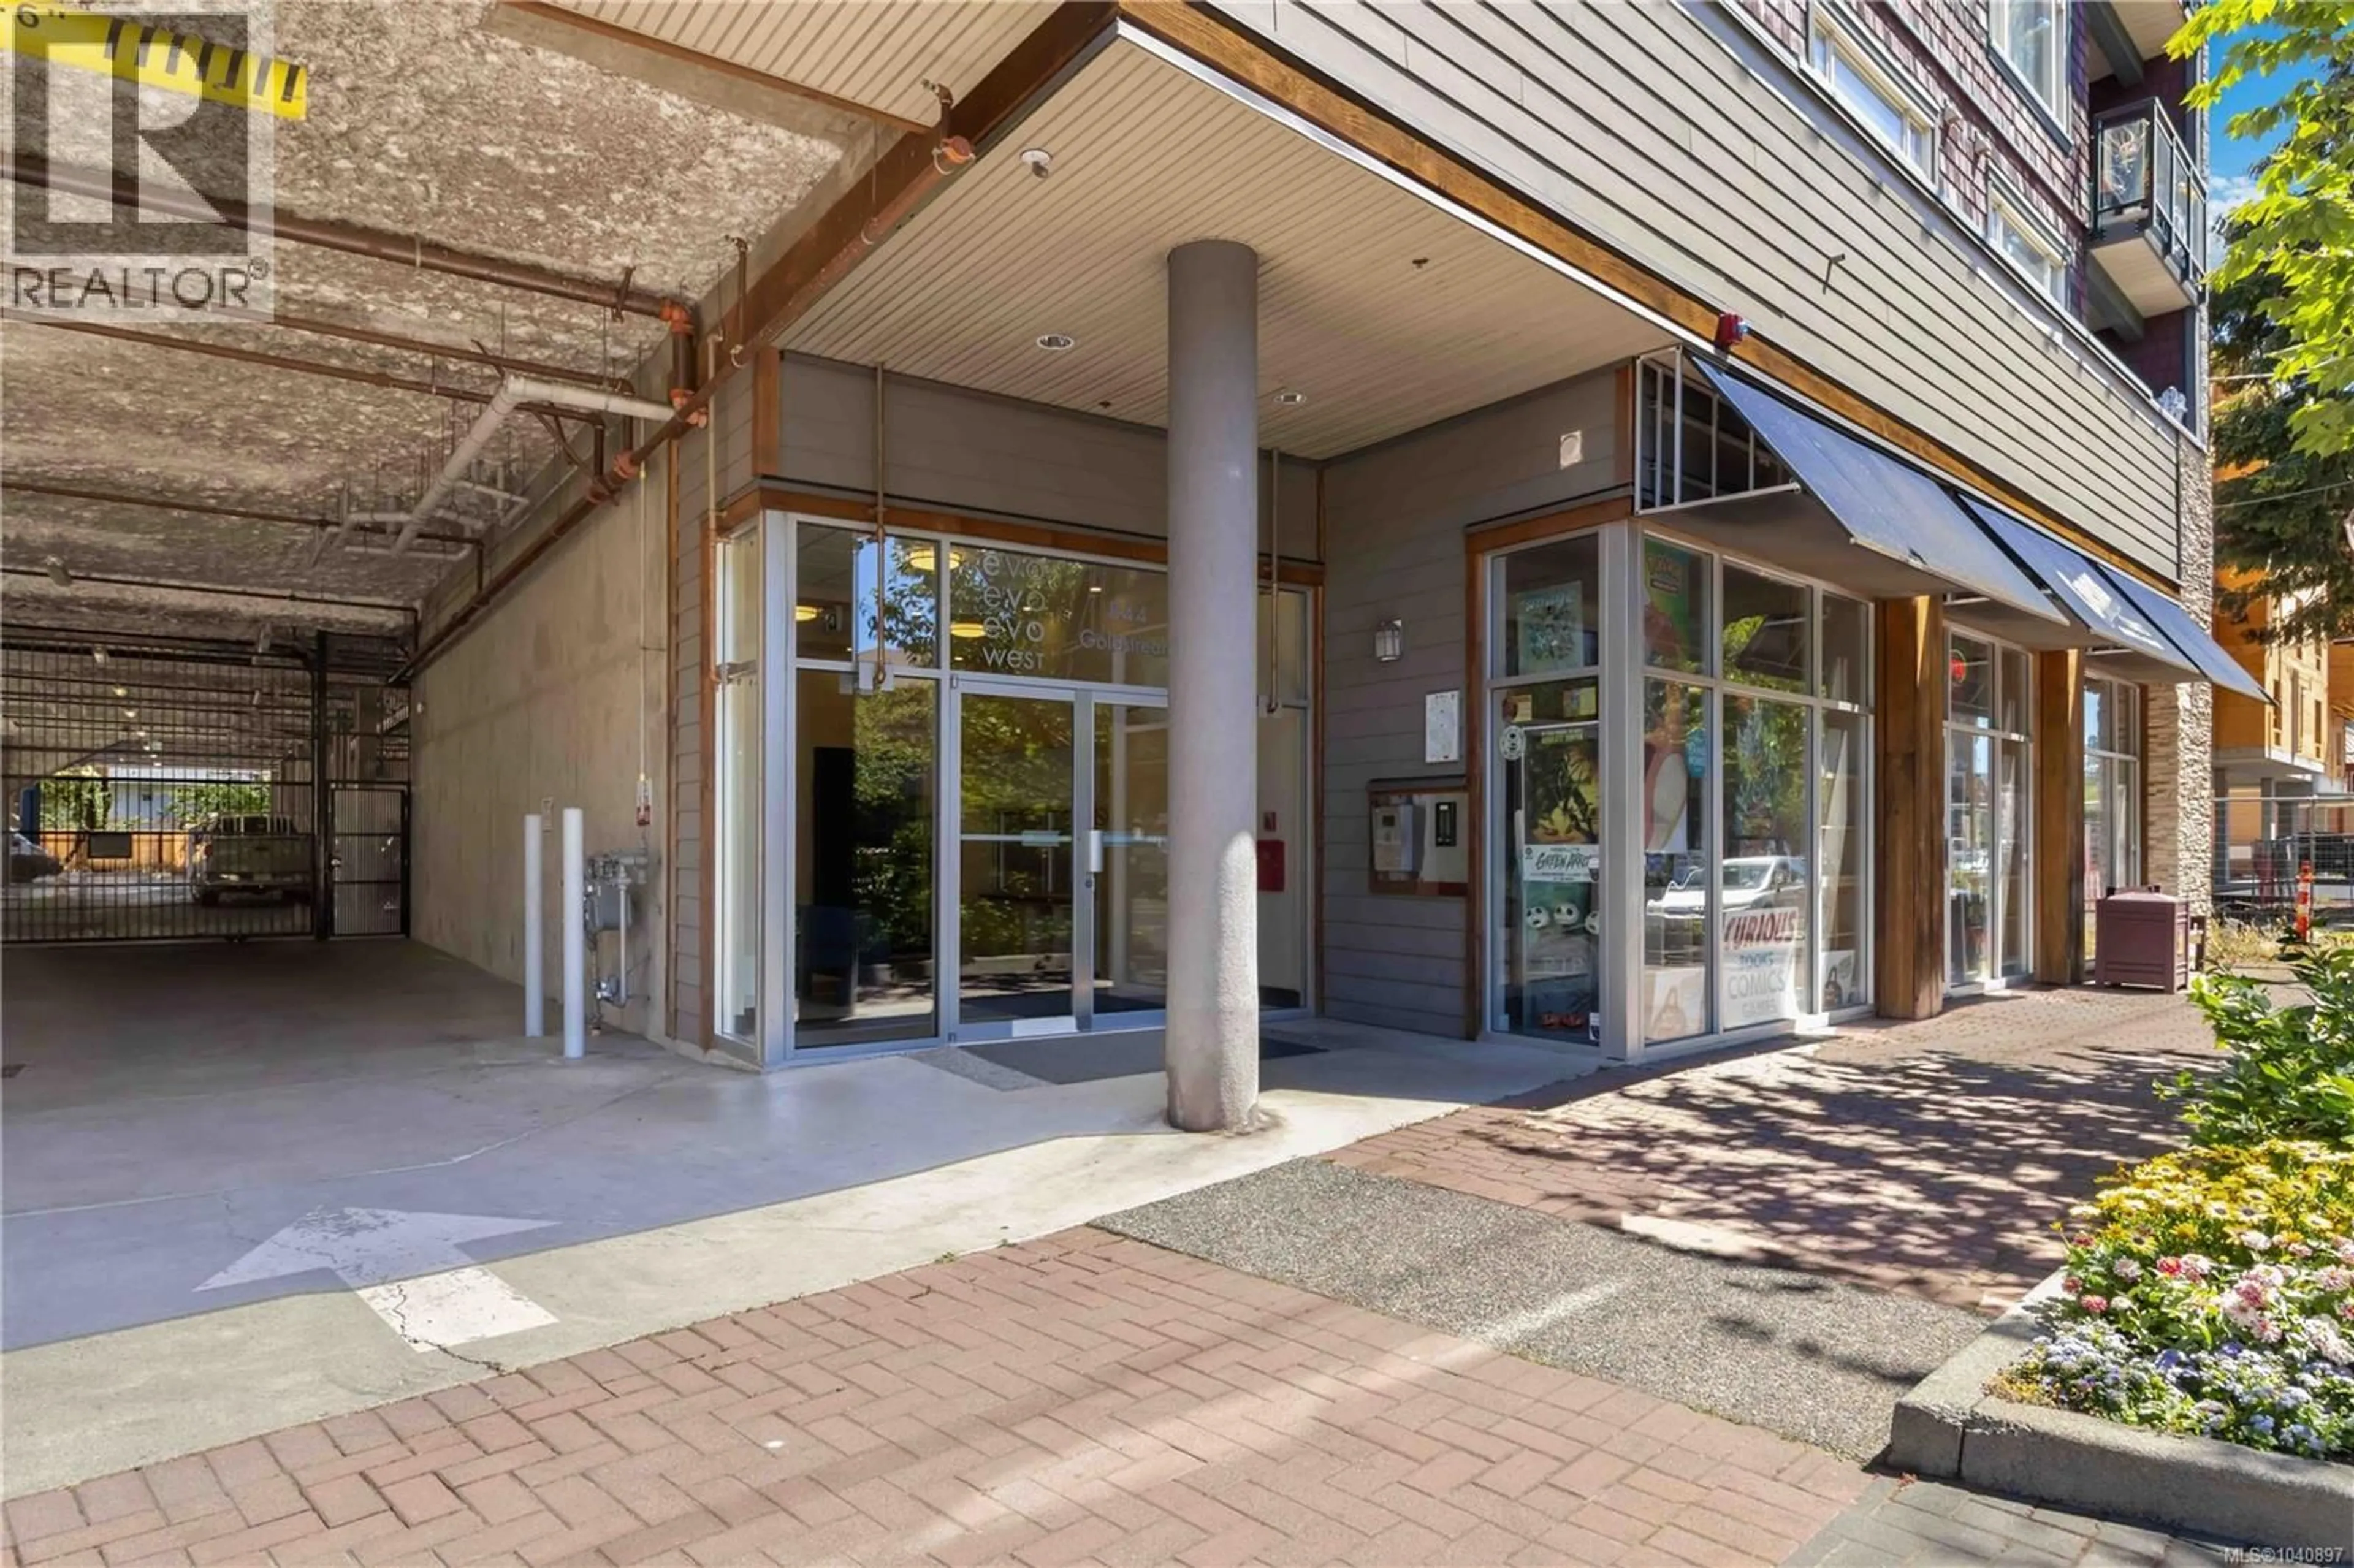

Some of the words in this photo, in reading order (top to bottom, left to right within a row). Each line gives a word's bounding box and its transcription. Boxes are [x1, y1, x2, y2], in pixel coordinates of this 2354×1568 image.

[984, 586, 1046, 612] evo
[983, 617, 1045, 642] evo
[1079, 629, 1170, 657] Goldstrea
[1723, 910, 1797, 950] CURIOUS
[1727, 967, 1785, 999] COMICS
